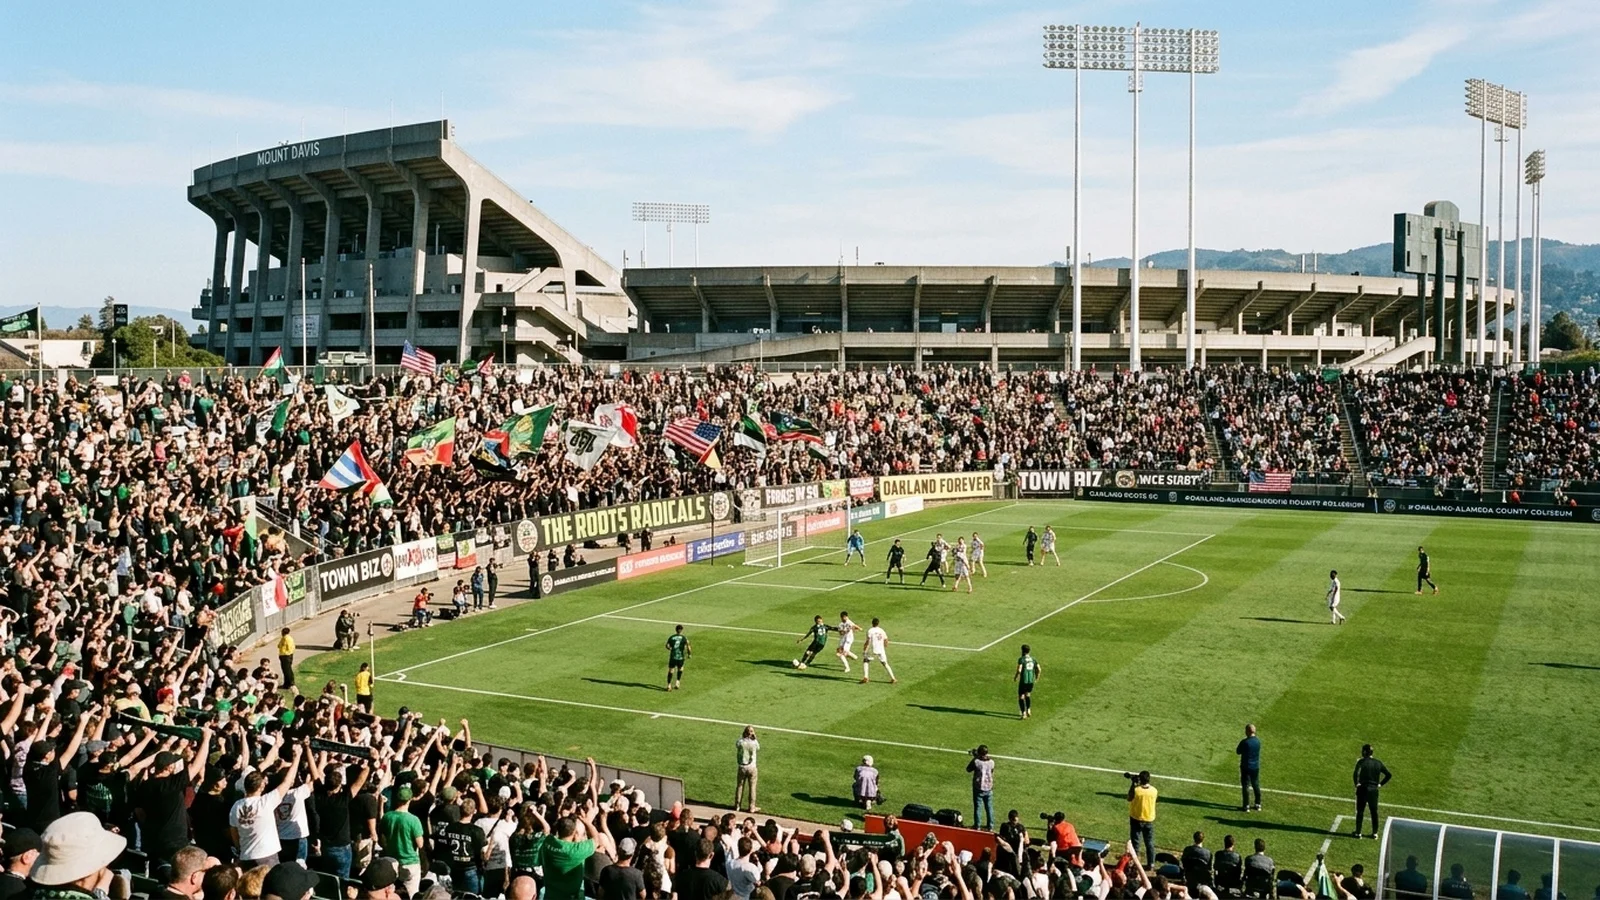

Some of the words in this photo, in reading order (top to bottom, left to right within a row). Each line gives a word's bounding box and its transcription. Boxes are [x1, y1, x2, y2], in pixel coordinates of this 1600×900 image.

[257, 147, 289, 166] MOUNT
[291, 141, 320, 160] DAVIS
[939, 476, 991, 493] FOREVER
[1018, 471, 1070, 491] TOWN
[541, 515, 574, 546] THE
[574, 507, 628, 540] ROOTS
[630, 496, 706, 530] RADICALS
[1495, 507, 1529, 515] COUNTY
[320, 563, 360, 593] TOWN
[360, 557, 382, 581] BIZ
